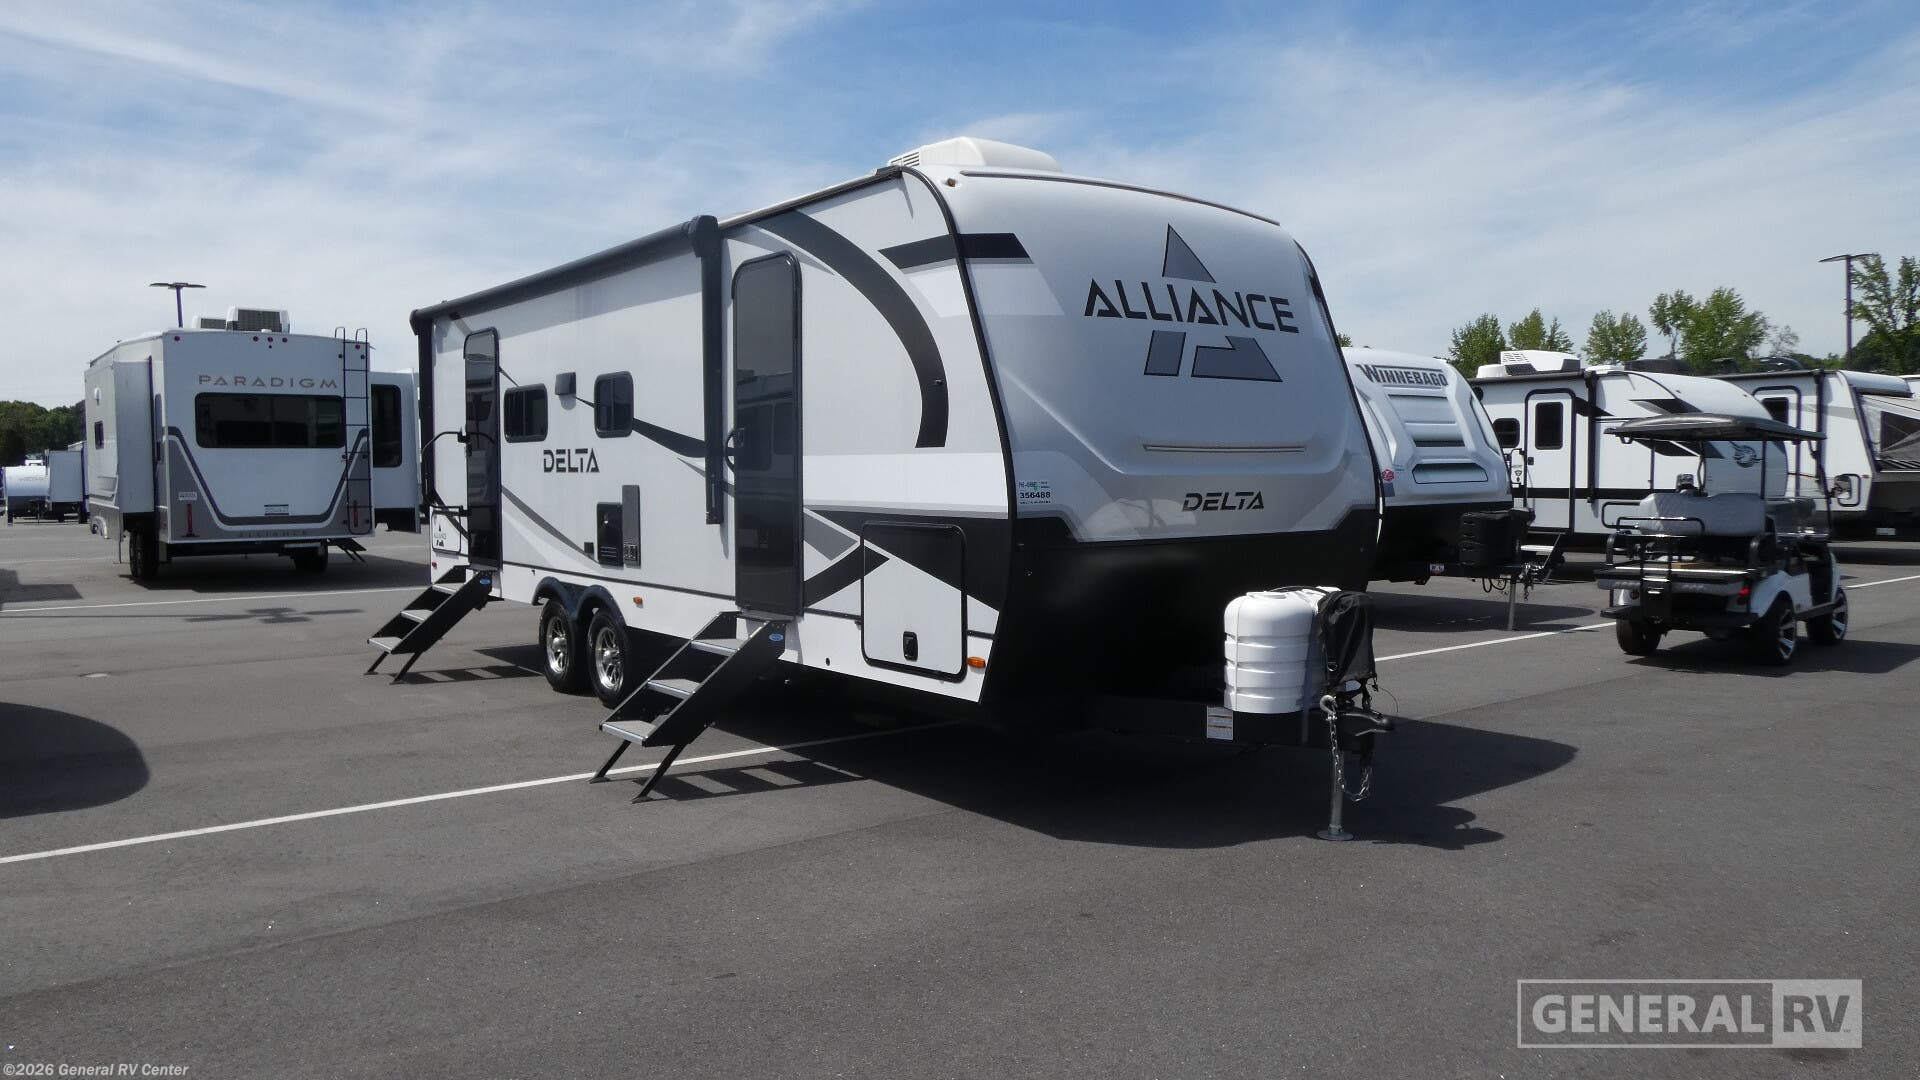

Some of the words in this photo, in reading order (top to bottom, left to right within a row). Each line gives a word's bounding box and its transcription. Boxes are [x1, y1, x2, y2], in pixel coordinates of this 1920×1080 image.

[1084, 278, 1299, 333] ALLIANCE
[198, 375, 338, 389] PARADIGM
[1356, 364, 1448, 387] WINNEBAGO
[543, 448, 600, 473] DELTA
[1019, 491, 1051, 499] 356488
[1182, 490, 1265, 512] DELTA
